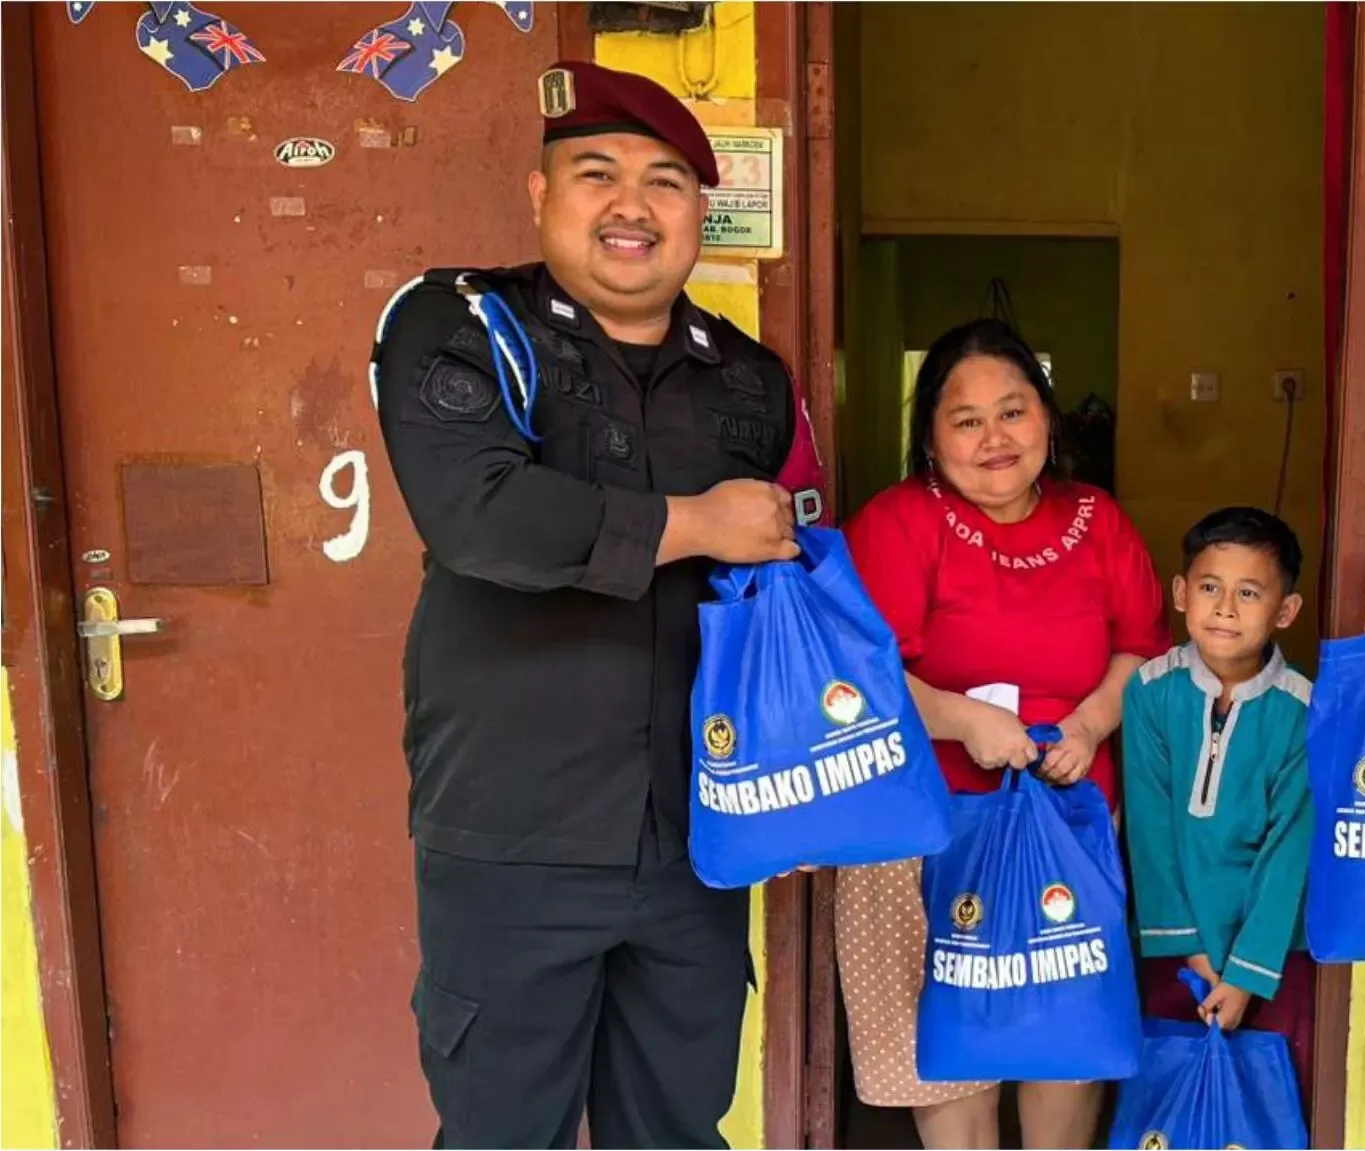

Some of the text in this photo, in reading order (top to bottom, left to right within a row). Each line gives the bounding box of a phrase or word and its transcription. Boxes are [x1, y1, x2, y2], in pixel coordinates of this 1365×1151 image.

[699, 763, 815, 816] SEMBAKO
[814, 731, 906, 797] IMIPAS
[933, 938, 1108, 990] SEMBAKO IMIPAS
